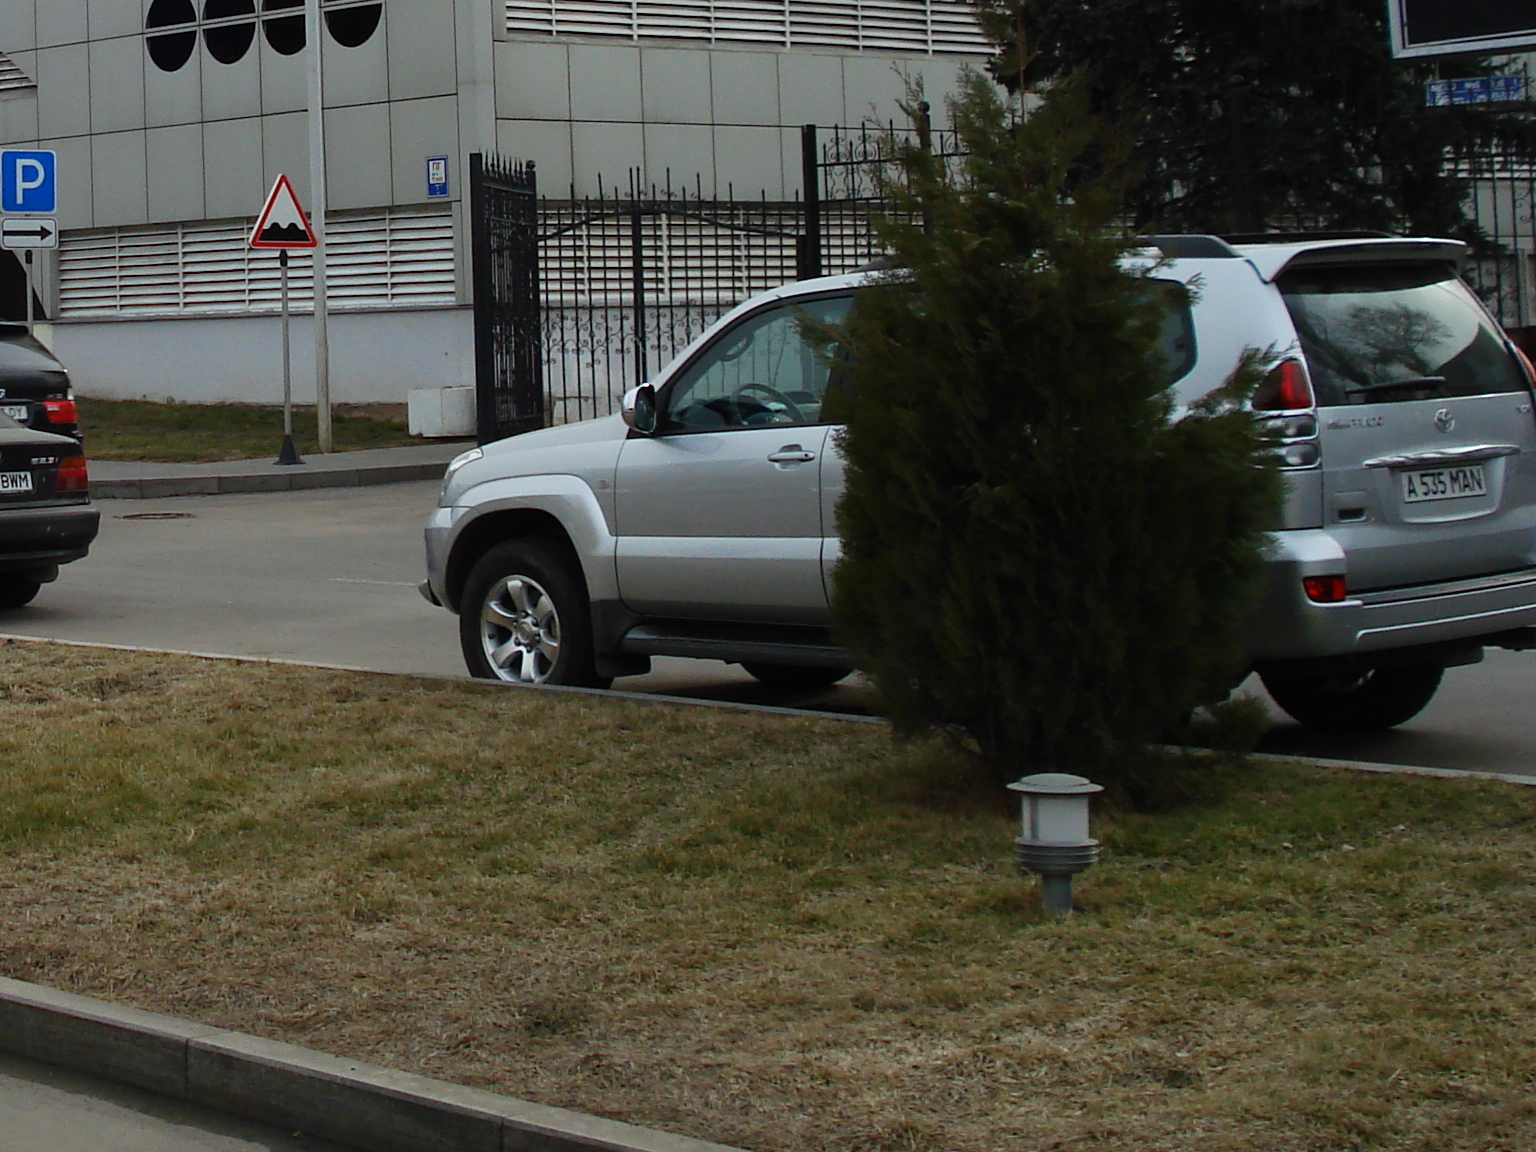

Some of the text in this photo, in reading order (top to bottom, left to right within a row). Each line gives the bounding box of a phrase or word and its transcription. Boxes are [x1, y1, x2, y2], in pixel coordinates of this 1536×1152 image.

[16, 158, 45, 205] P
[0, 472, 29, 489] BWM
[1408, 469, 1483, 498] A 535 MAN
